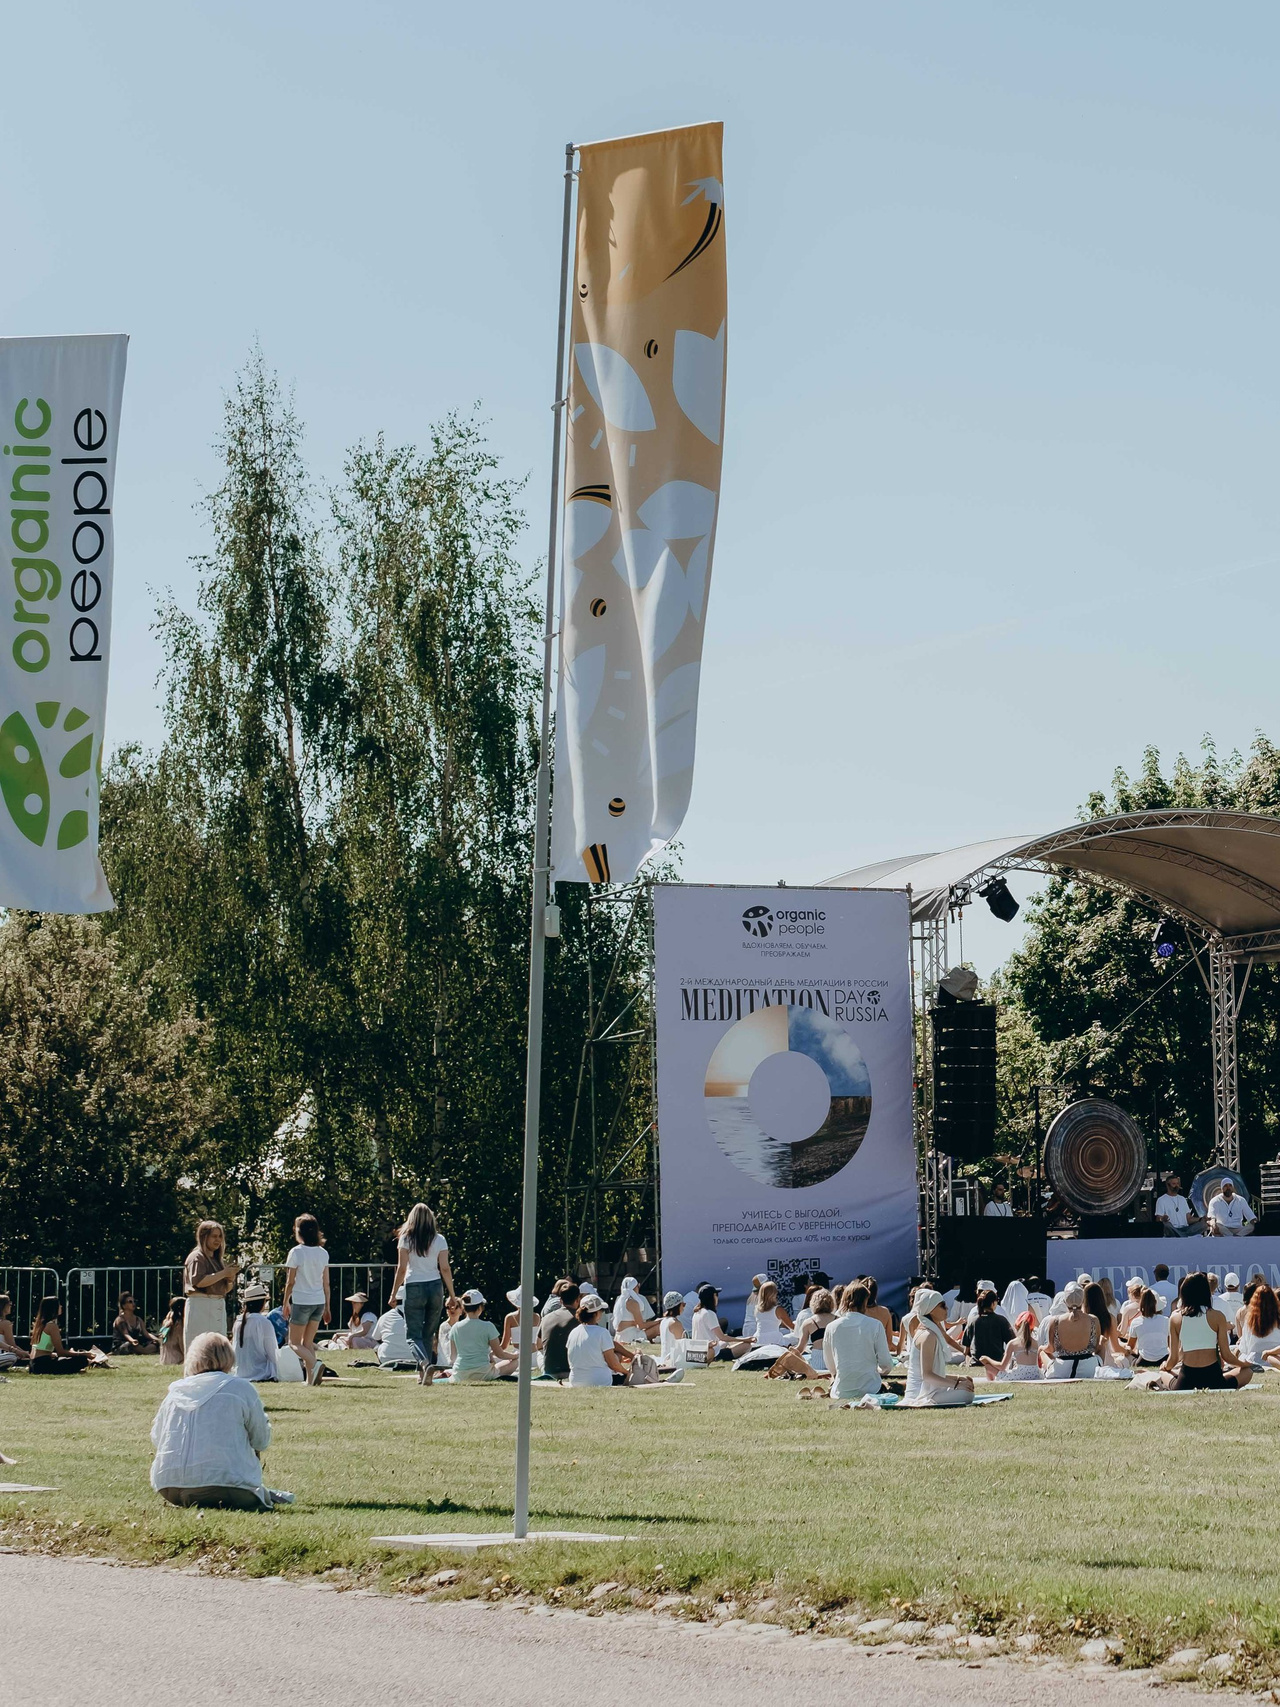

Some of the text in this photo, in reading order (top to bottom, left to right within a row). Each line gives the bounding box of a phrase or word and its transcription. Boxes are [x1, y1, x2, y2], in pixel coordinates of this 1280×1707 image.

[3, 397, 62, 673] organic
[61, 407, 111, 662] people
[776, 908, 827, 923] organic
[778, 922, 825, 937] people
[694, 977, 773, 987] МЕЖДУНАРОДНЫЙ
[774, 978, 795, 987] ДЕНЬ
[797, 979, 846, 987] МЕДИТАЦИИ
[848, 979, 852, 987] В
[854, 980, 889, 988] РОССИИ
[680, 988, 866, 1021] MEDITATION DAY
[835, 1006, 889, 1022] RUSSIA
[742, 1210, 783, 1220] УЧИТЕСЬ
[785, 1210, 792, 1219] С
[712, 1220, 871, 1232] ПРЕПОДАВАЙТЕ С УВЕРЕННОСТЬЮ
[804, 1234, 820, 1242] 40%
[848, 1234, 871, 1243] курсы
